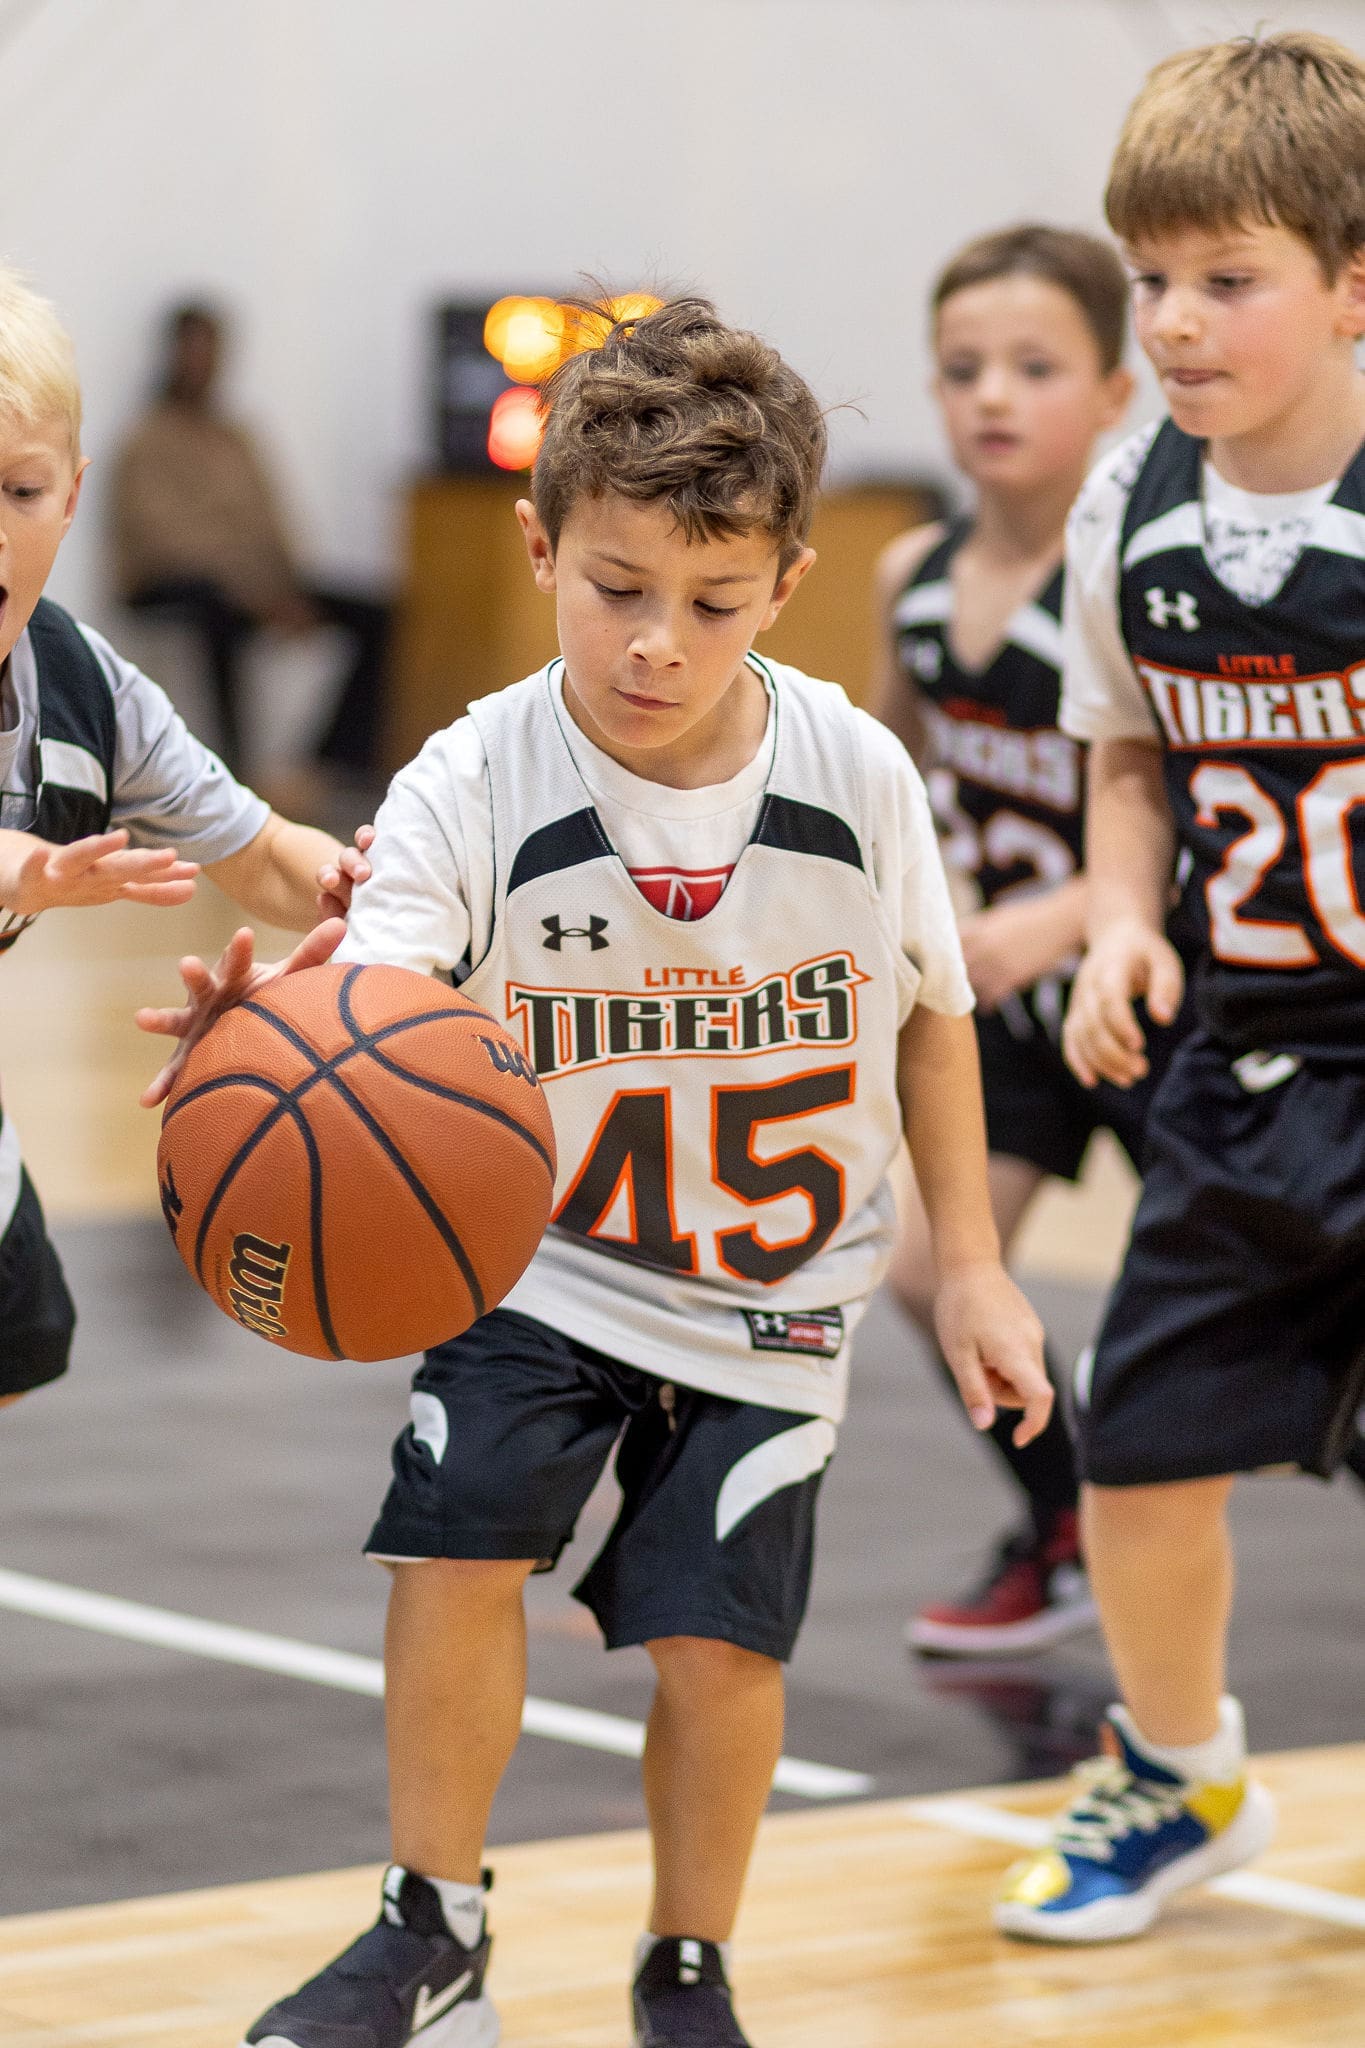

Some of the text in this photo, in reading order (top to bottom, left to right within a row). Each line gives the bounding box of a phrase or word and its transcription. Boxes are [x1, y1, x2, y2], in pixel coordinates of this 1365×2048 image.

[1217, 654, 1297, 676] LITTLE
[508, 954, 862, 1078] TIGERS
[644, 964, 746, 987] LITTLE
[551, 1061, 856, 1286] 45
[229, 1231, 293, 1338] Wil
